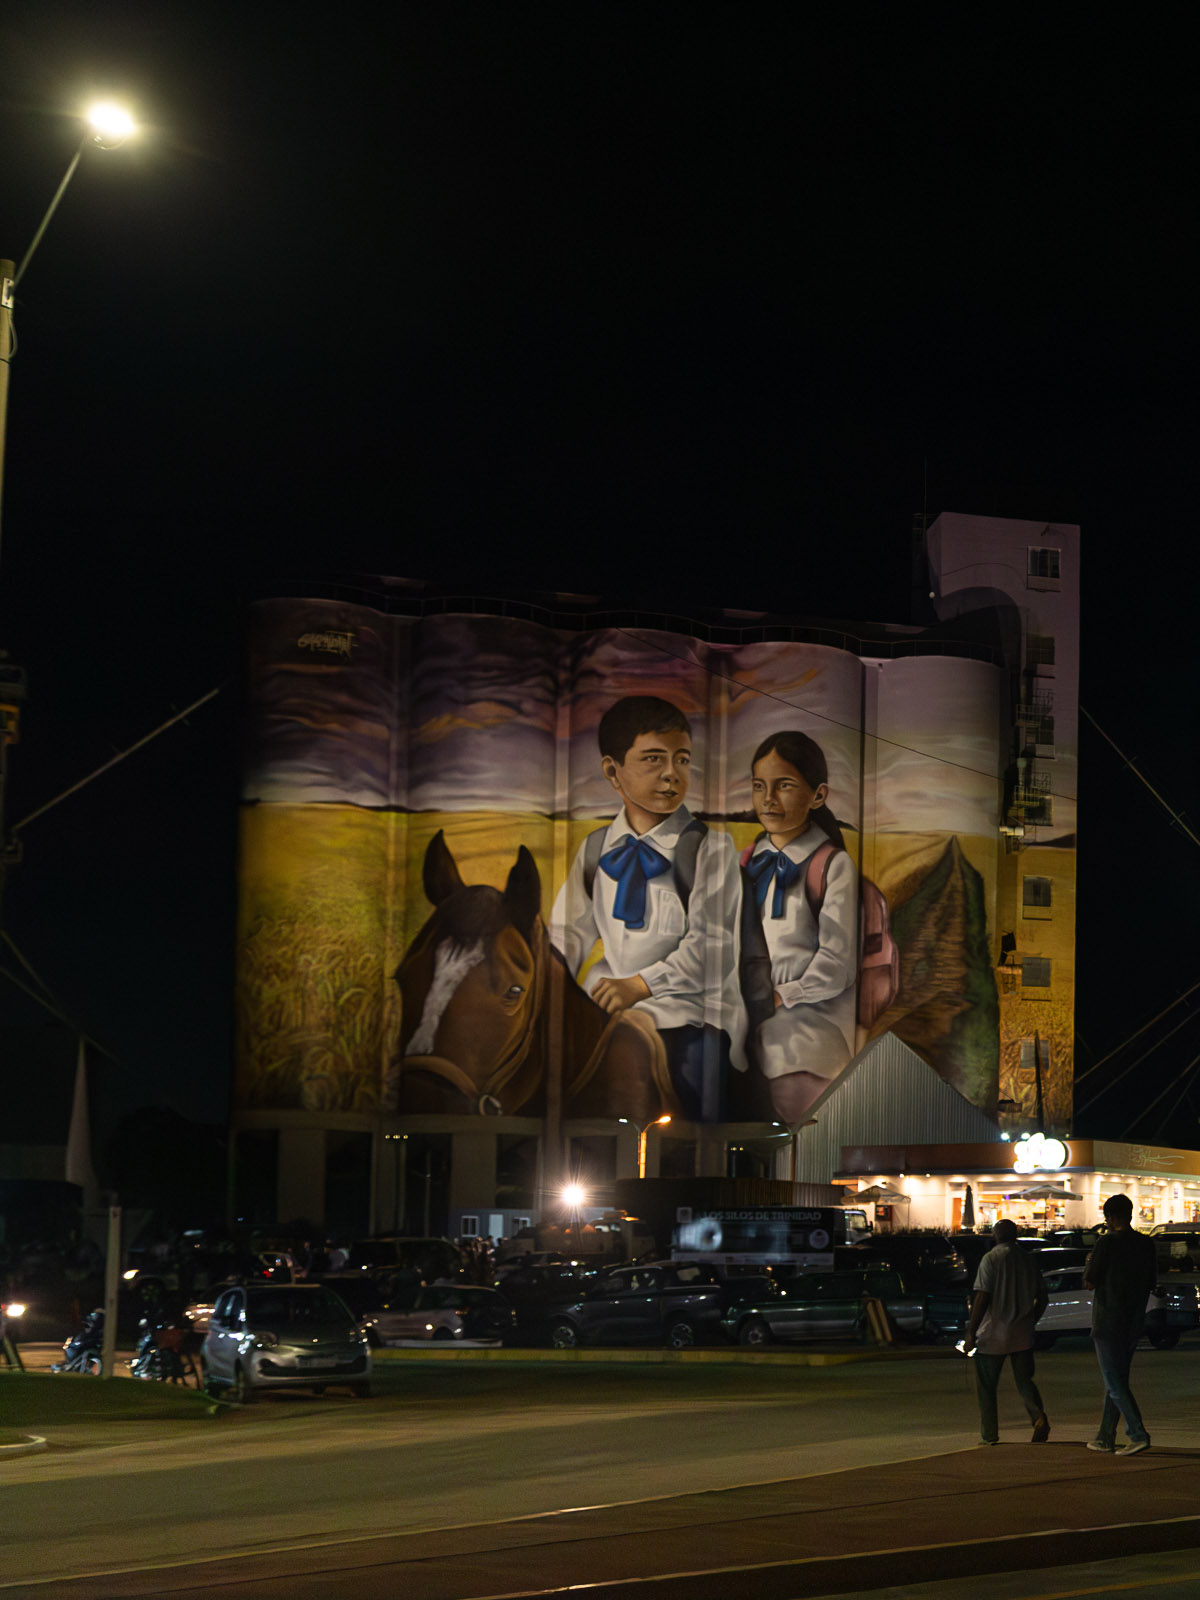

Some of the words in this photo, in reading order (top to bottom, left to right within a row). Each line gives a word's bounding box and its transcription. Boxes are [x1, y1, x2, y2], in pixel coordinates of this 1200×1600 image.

[705, 1211, 723, 1221] LOS
[726, 1211, 753, 1221] SILOS
[755, 1211, 769, 1221] DE
[771, 1211, 822, 1221] TRINIDAD
